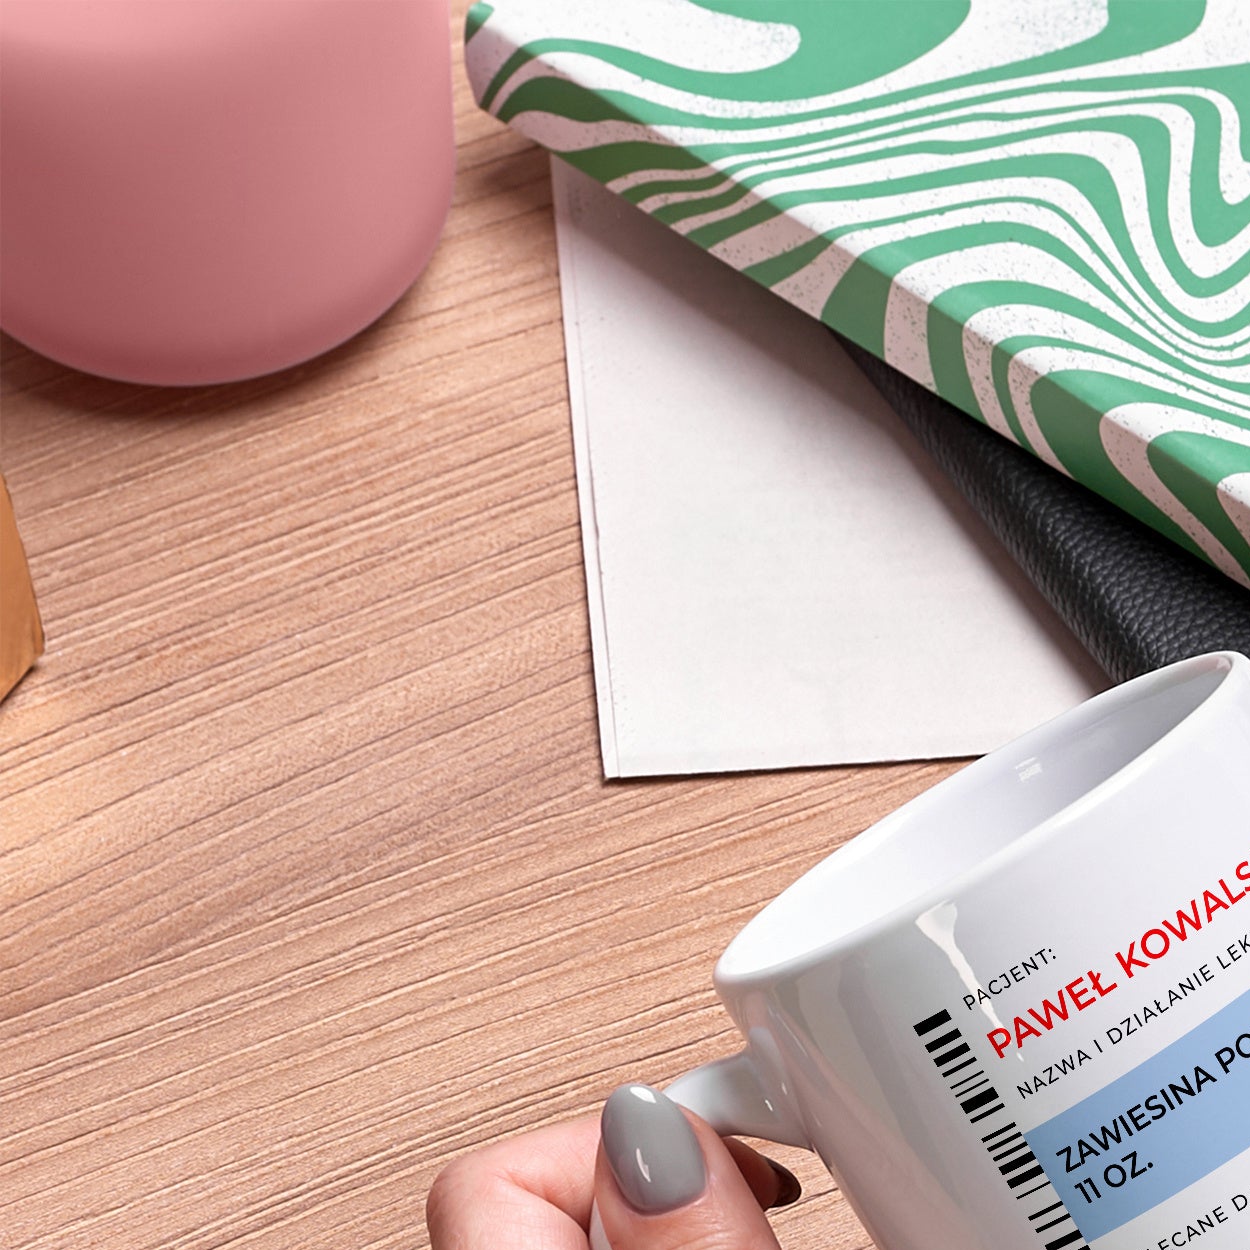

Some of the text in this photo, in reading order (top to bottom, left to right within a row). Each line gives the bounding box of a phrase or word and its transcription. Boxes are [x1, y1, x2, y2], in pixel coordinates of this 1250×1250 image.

[962, 948, 1057, 1011] PACJENT:
[986, 970, 1117, 1059] PAWEŁ
[1016, 1049, 1091, 1100] NAZWA
[1094, 1041, 1104, 1053] I
[1105, 970, 1213, 1045] DZIAŁANIE
[1055, 1065, 1218, 1174] ZAWIESINA
[1073, 1151, 1154, 1204] 11 OZ.
